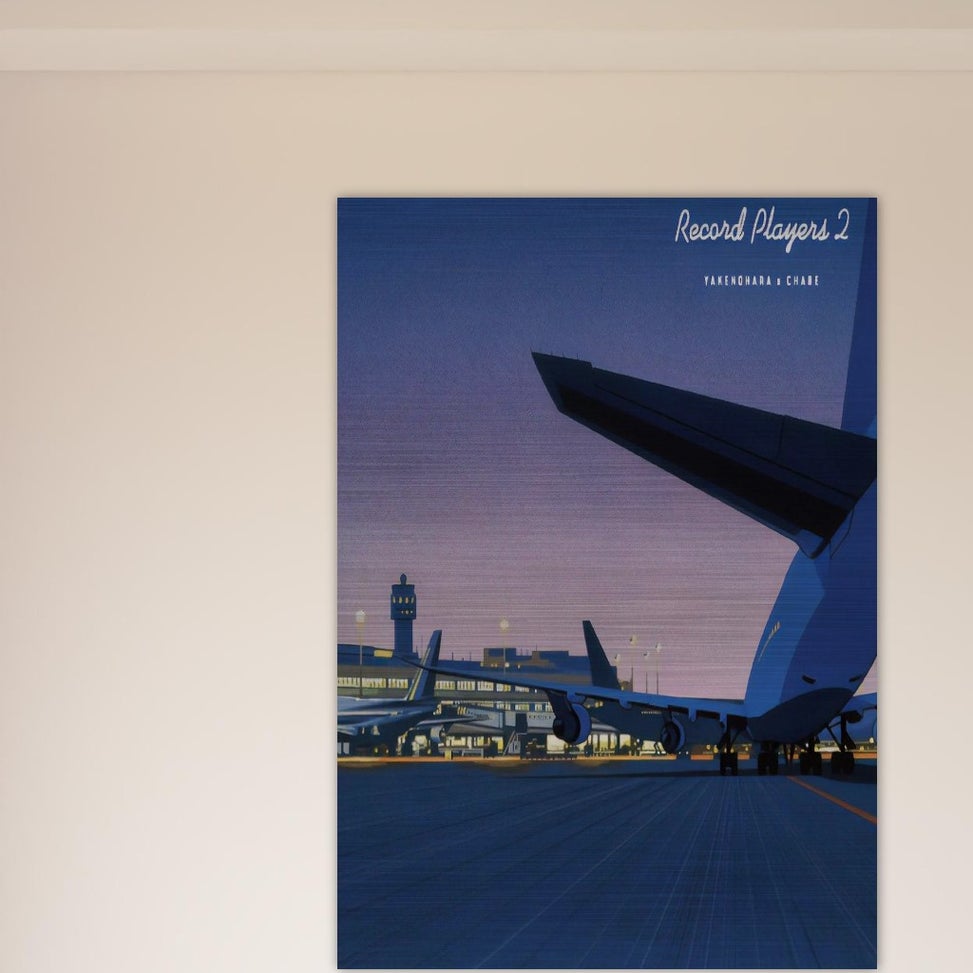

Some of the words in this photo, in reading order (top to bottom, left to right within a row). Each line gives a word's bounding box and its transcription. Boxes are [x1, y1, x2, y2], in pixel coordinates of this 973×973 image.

[675, 206, 747, 243] Record
[750, 206, 830, 254] Players
[834, 207, 850, 240] 2
[704, 275, 772, 287] YAKENOHARA
[786, 275, 819, 286] CHABE
